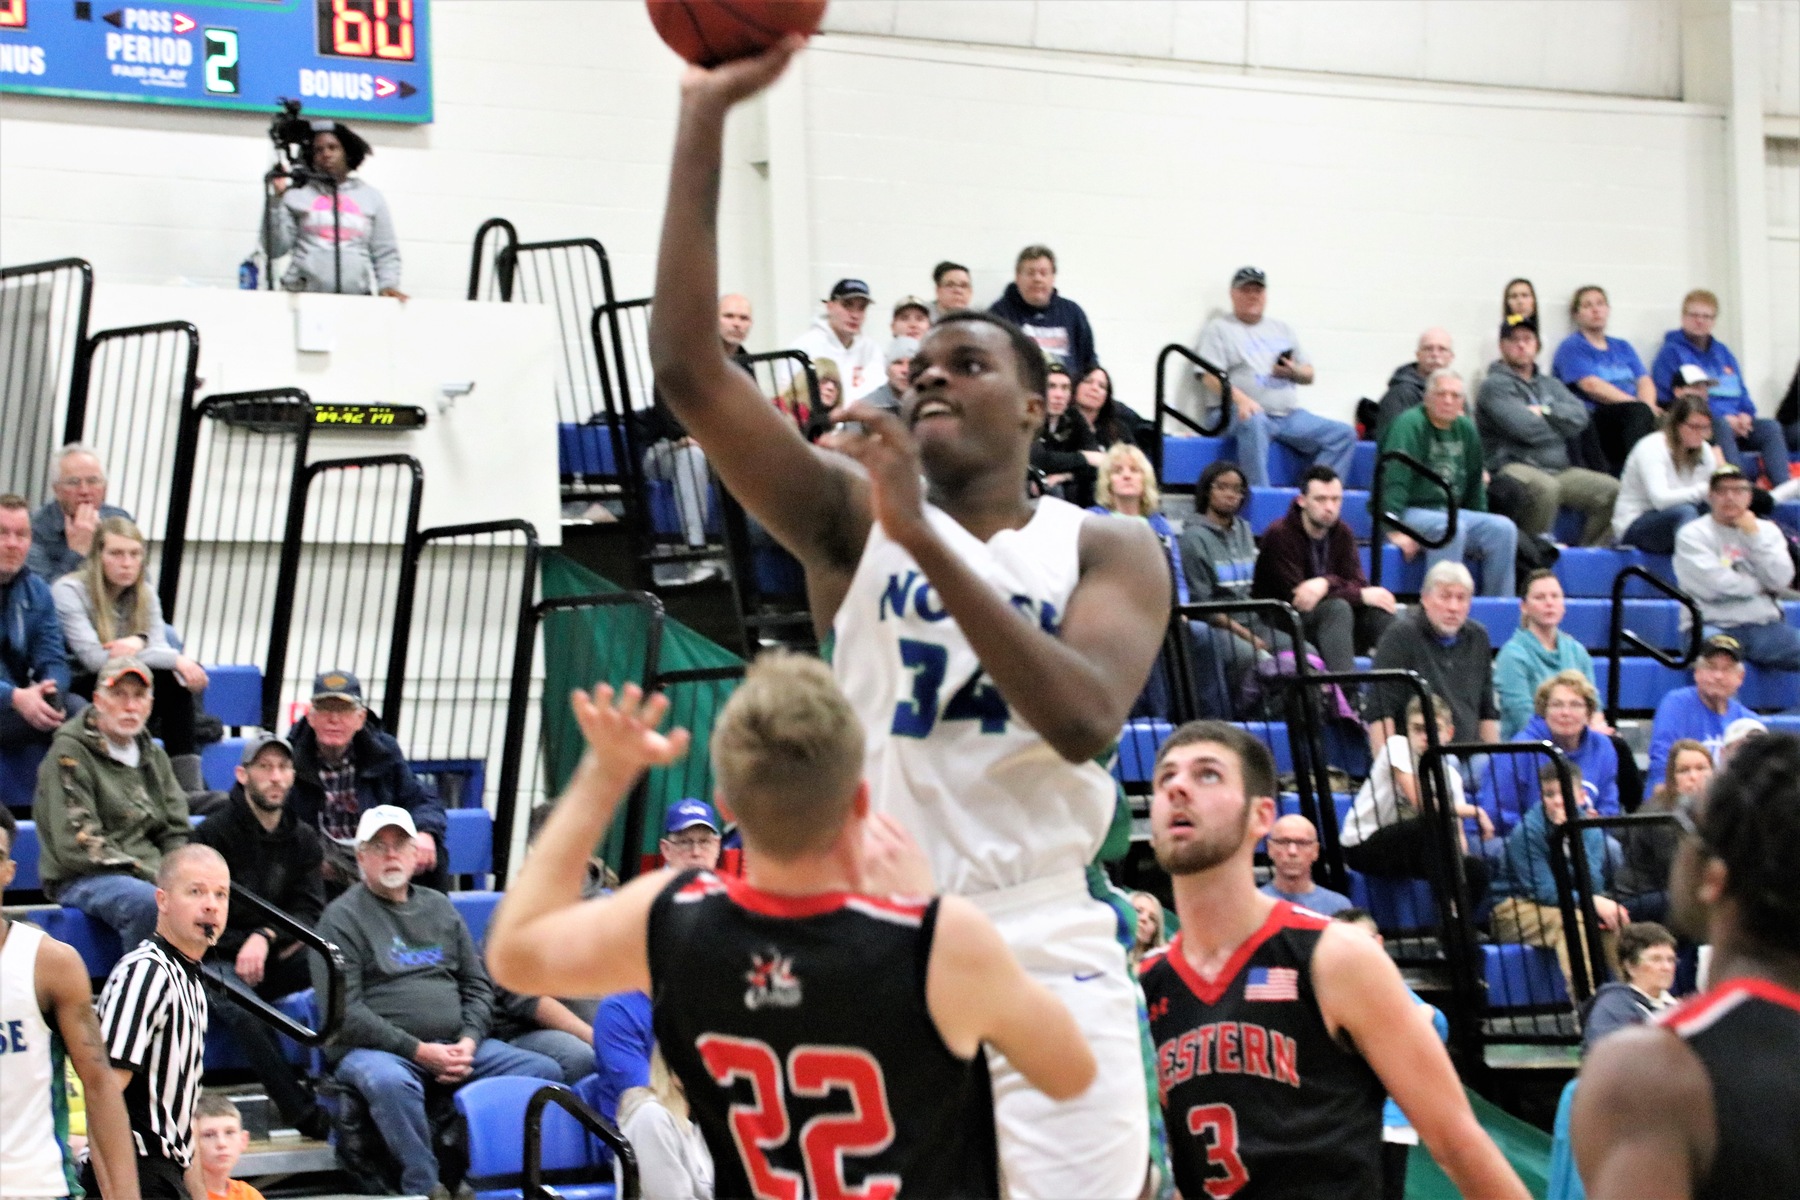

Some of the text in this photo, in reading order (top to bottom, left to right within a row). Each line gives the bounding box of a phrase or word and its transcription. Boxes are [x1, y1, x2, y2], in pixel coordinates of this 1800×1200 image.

[106, 31, 192, 66] PERIOD
[124, 7, 172, 33] POSS
[331, 0, 414, 60] 60
[204, 29, 239, 93] 2
[299, 68, 374, 101] BONUS
[890, 637, 1011, 740] 34
[1156, 1020, 1301, 1106] ESTERN
[694, 1031, 902, 1200] 22
[1187, 1102, 1250, 1200] 3
